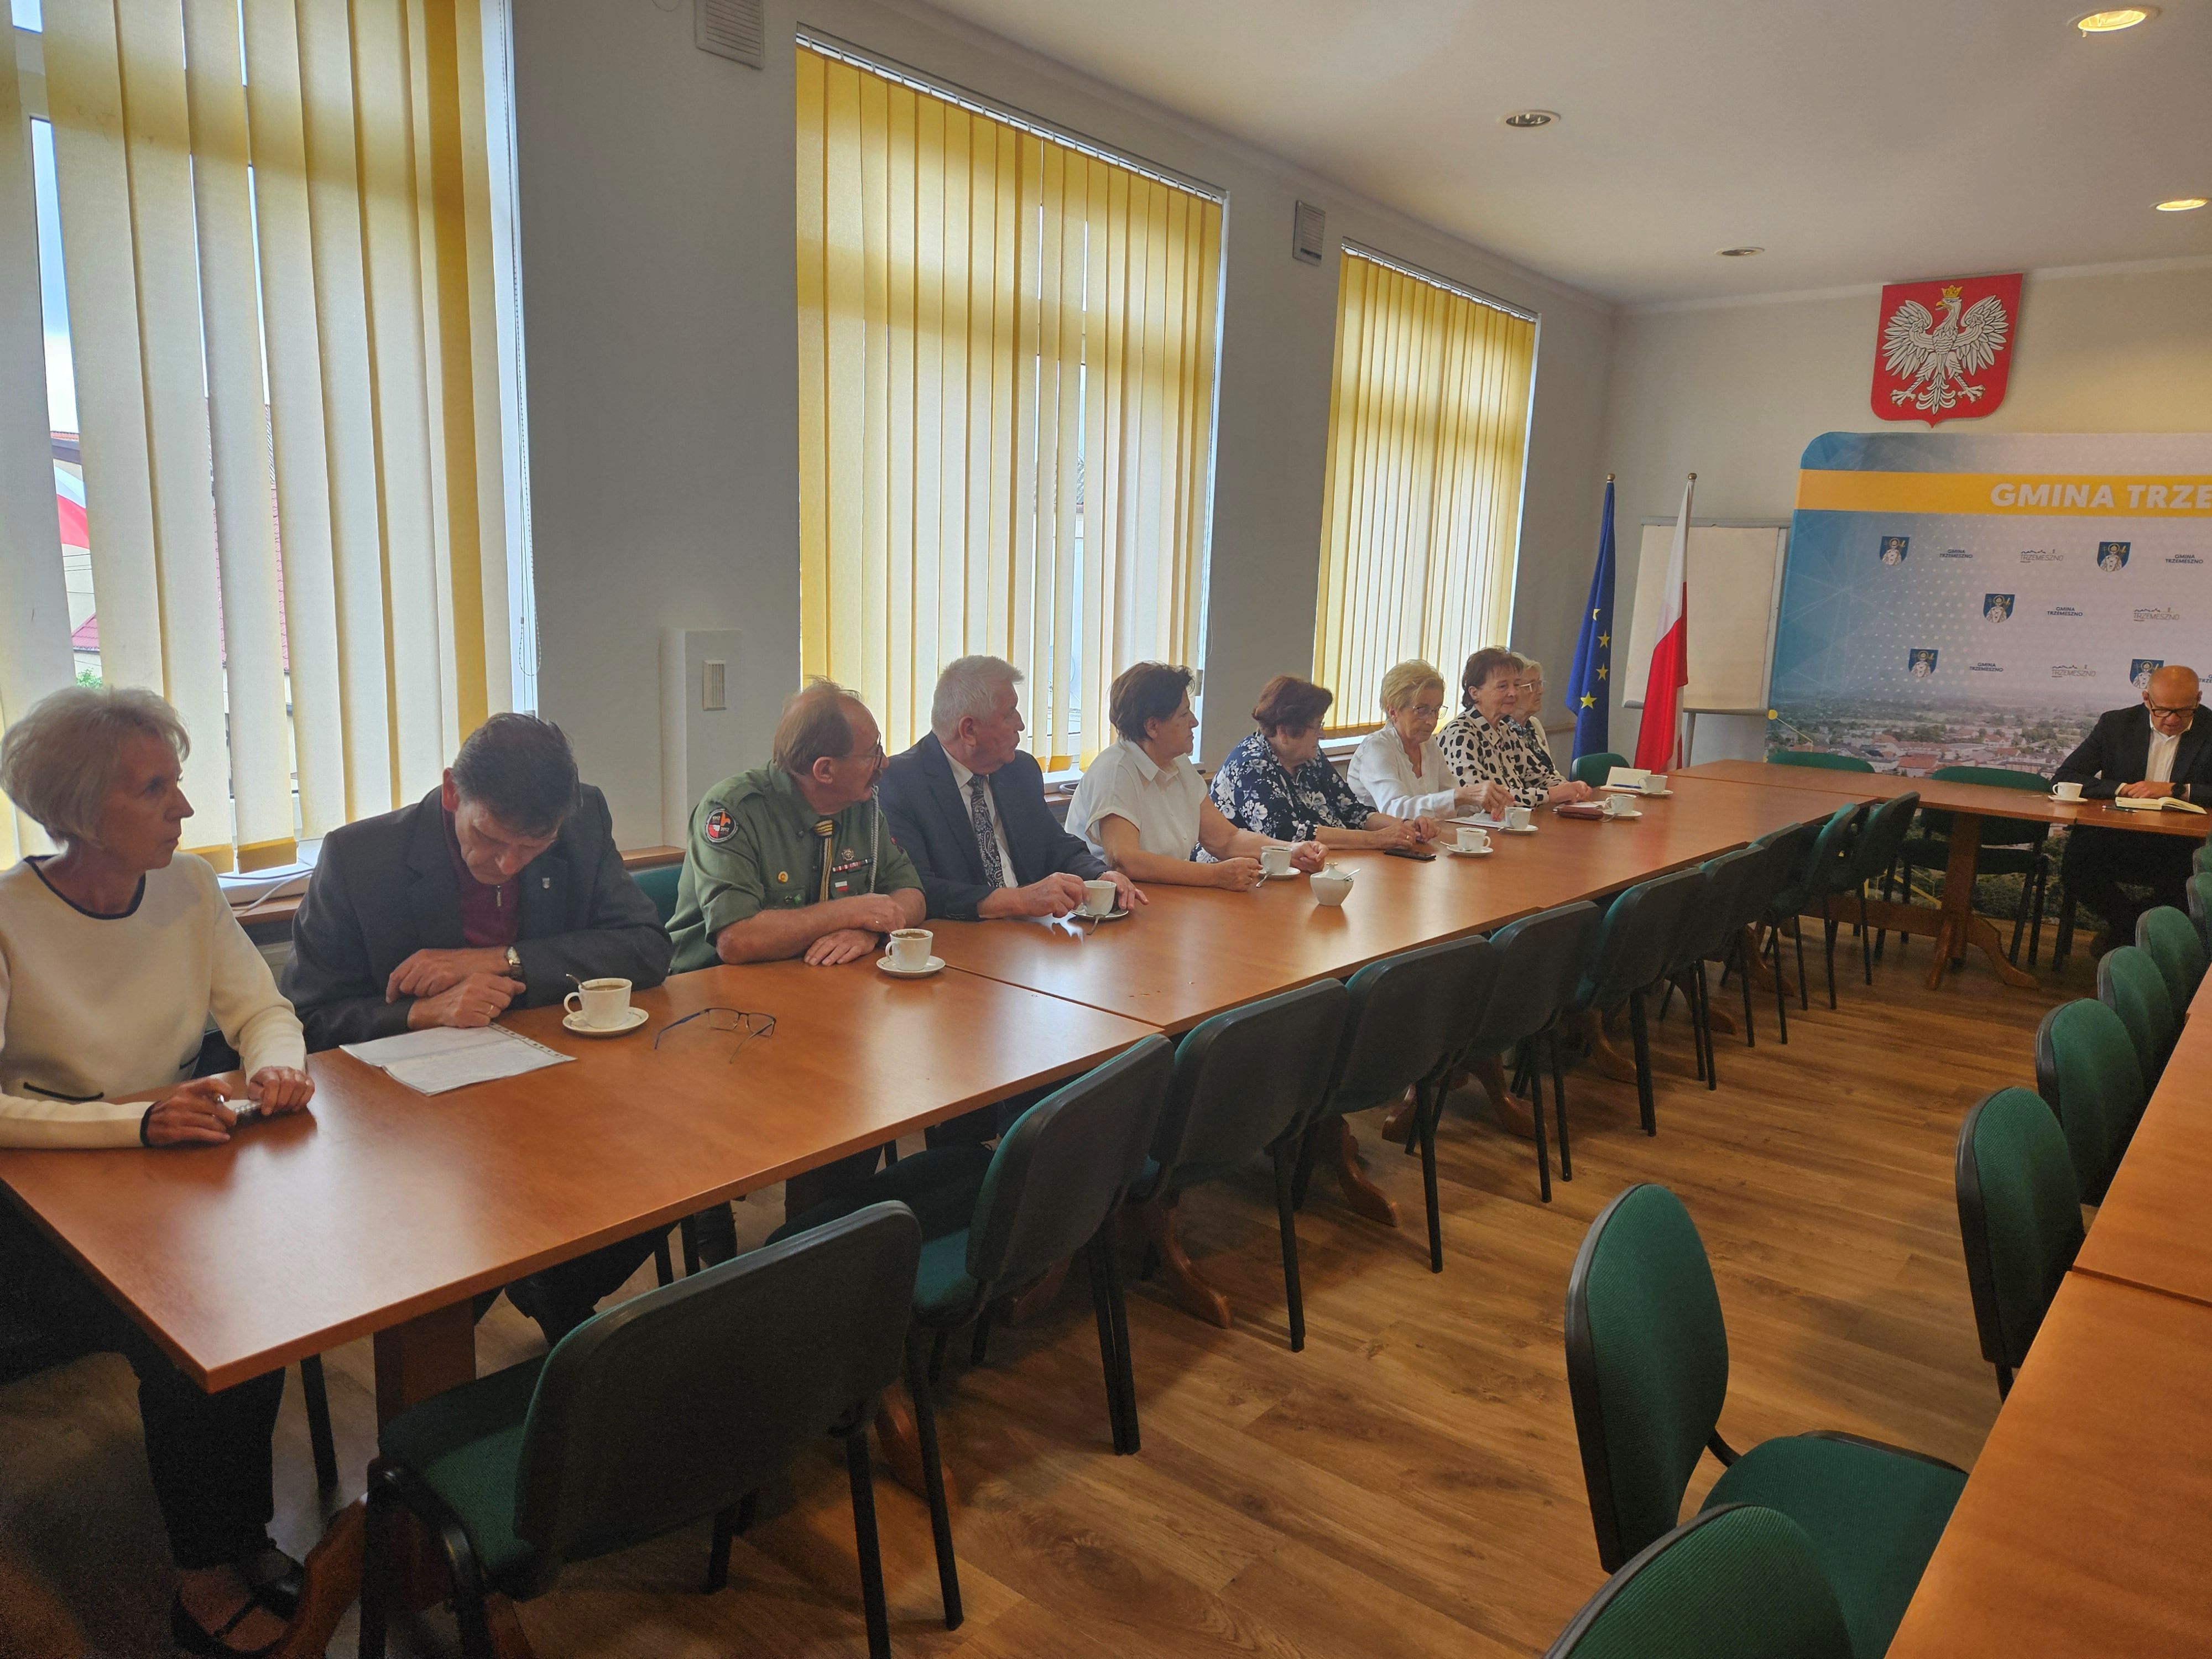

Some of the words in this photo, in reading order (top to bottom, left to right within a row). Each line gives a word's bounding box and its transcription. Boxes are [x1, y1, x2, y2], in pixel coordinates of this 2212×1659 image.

[1991, 483, 2115, 508] GMINA
[2127, 484, 2212, 509] TRZE
[2133, 612, 2180, 620] TRZEMESZNO
